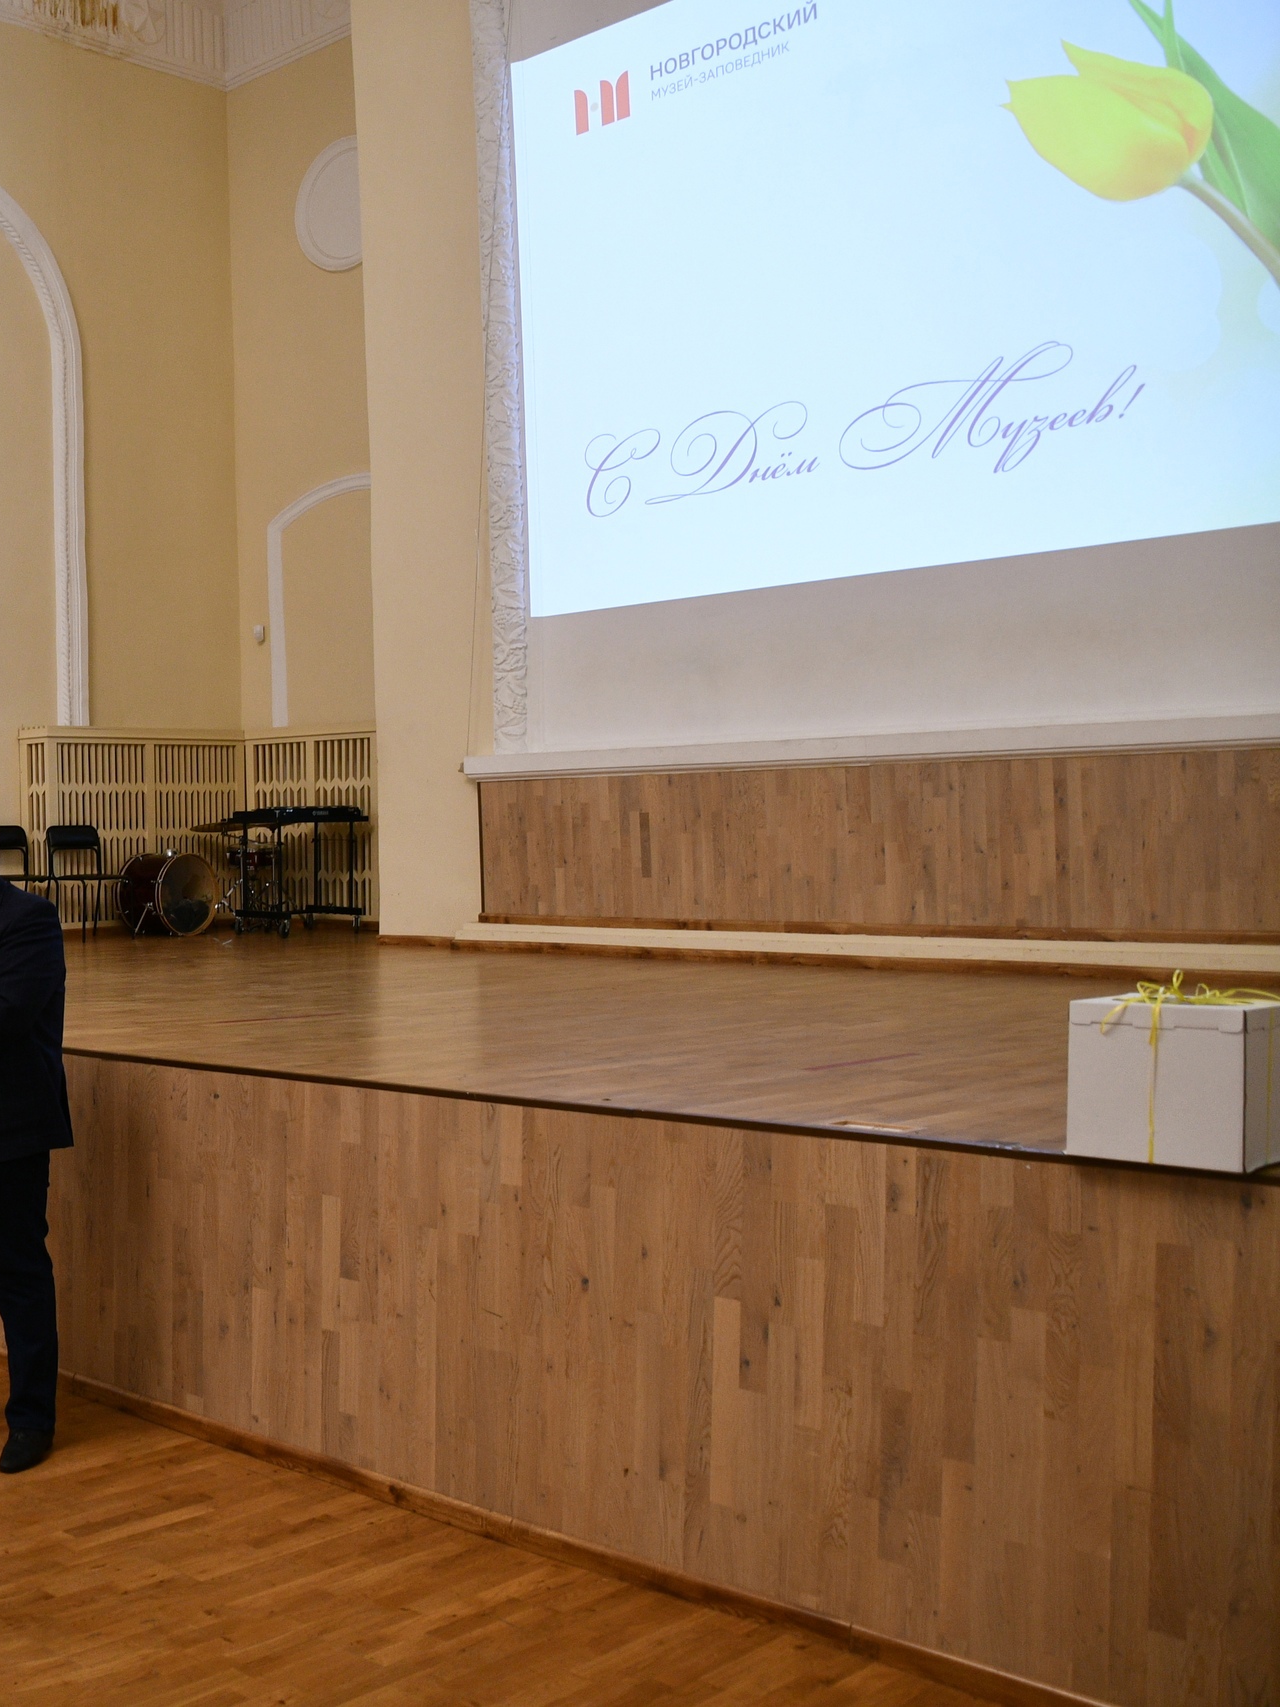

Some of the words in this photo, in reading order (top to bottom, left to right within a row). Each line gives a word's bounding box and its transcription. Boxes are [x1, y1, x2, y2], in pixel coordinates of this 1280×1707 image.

[650, 0, 818, 80] НОВГОРОДСКИЙ
[651, 41, 790, 101] МУЗЕЙ-ЗАПОВЕДНИК
[584, 428, 661, 517] С
[645, 400, 821, 505] Днём
[838, 340, 1146, 474] Музеев!
